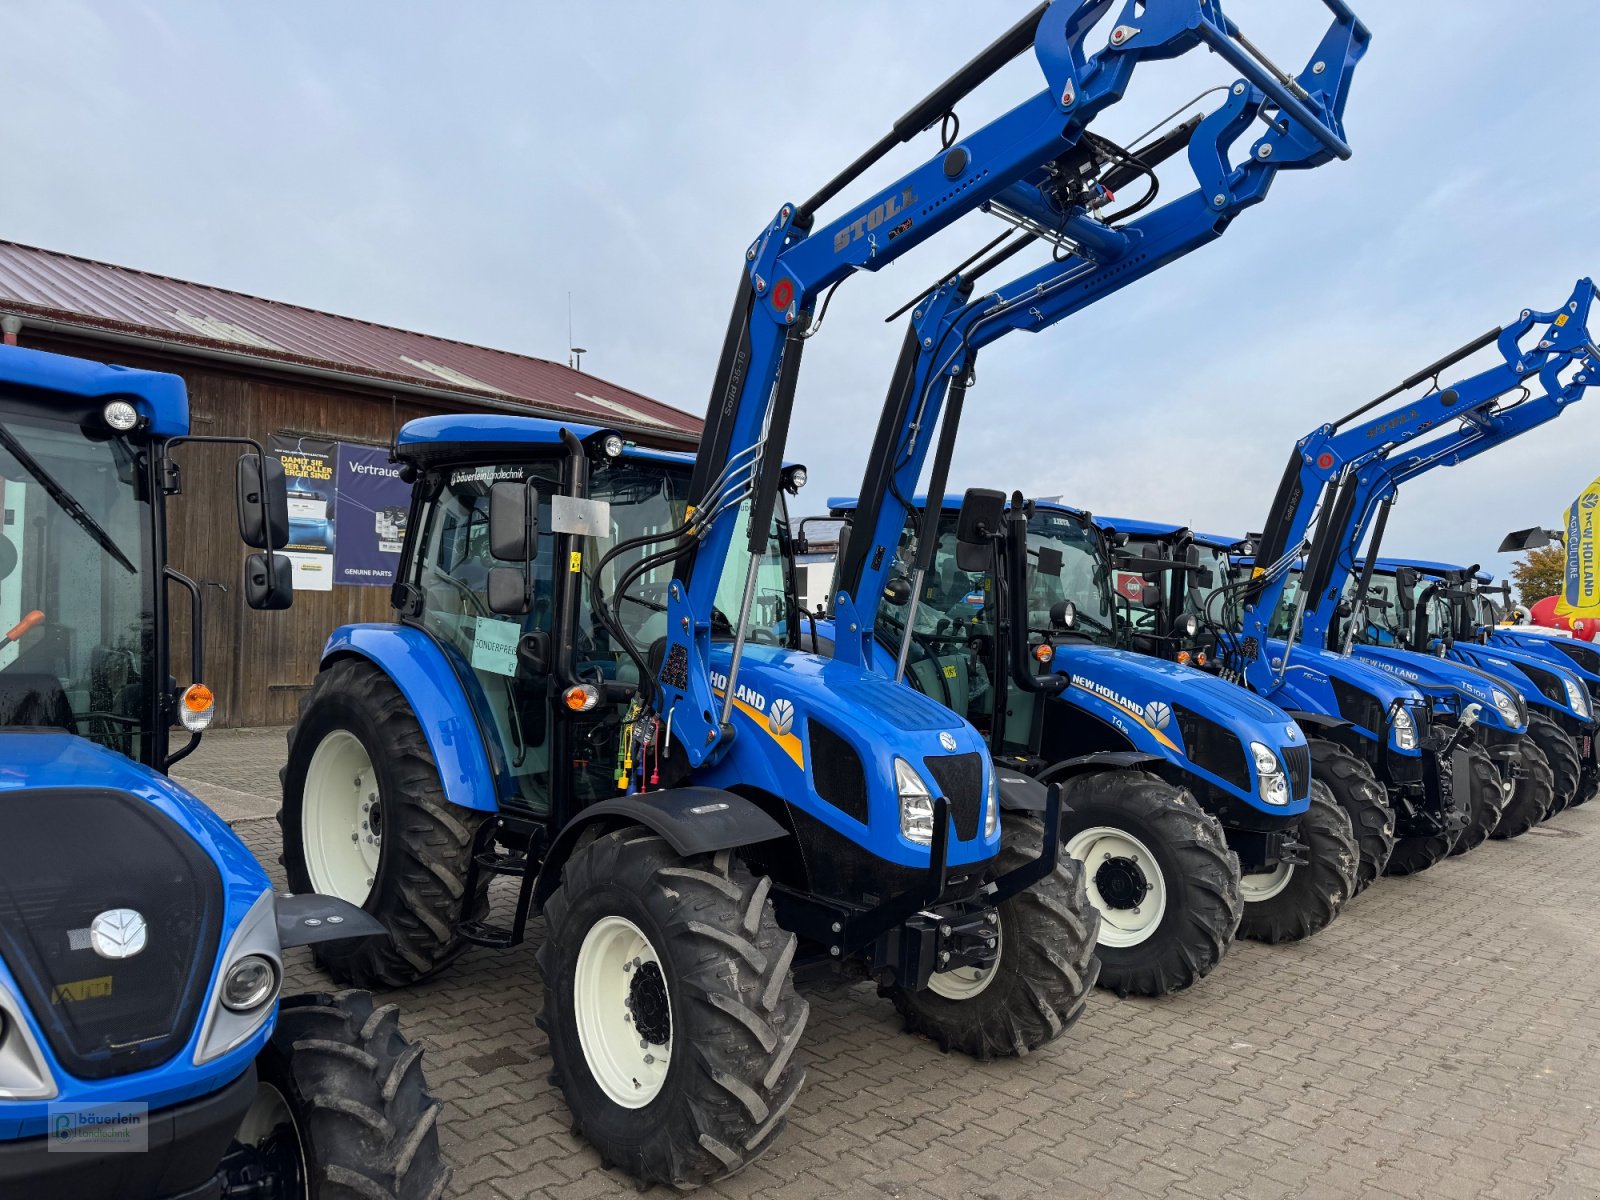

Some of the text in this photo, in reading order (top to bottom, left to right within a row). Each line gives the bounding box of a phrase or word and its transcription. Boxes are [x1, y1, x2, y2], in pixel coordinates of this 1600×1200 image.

[834, 185, 918, 253] STOLL
[725, 351, 746, 416] Solid 35-18
[281, 455, 323, 467] DAMIT SIE
[281, 462, 333, 474] MER VOLLER
[349, 461, 400, 478] Vertraue
[284, 469, 331, 480] ERGIE SIND
[344, 568, 371, 576] GENUINE
[1583, 541, 1594, 597] HOLLAND
[475, 639, 517, 655] SONDERPREIS
[1360, 656, 1418, 680] NEW HOLLAND
[710, 670, 766, 711] HOAND
[1072, 674, 1144, 716] NEW HOLLAND
